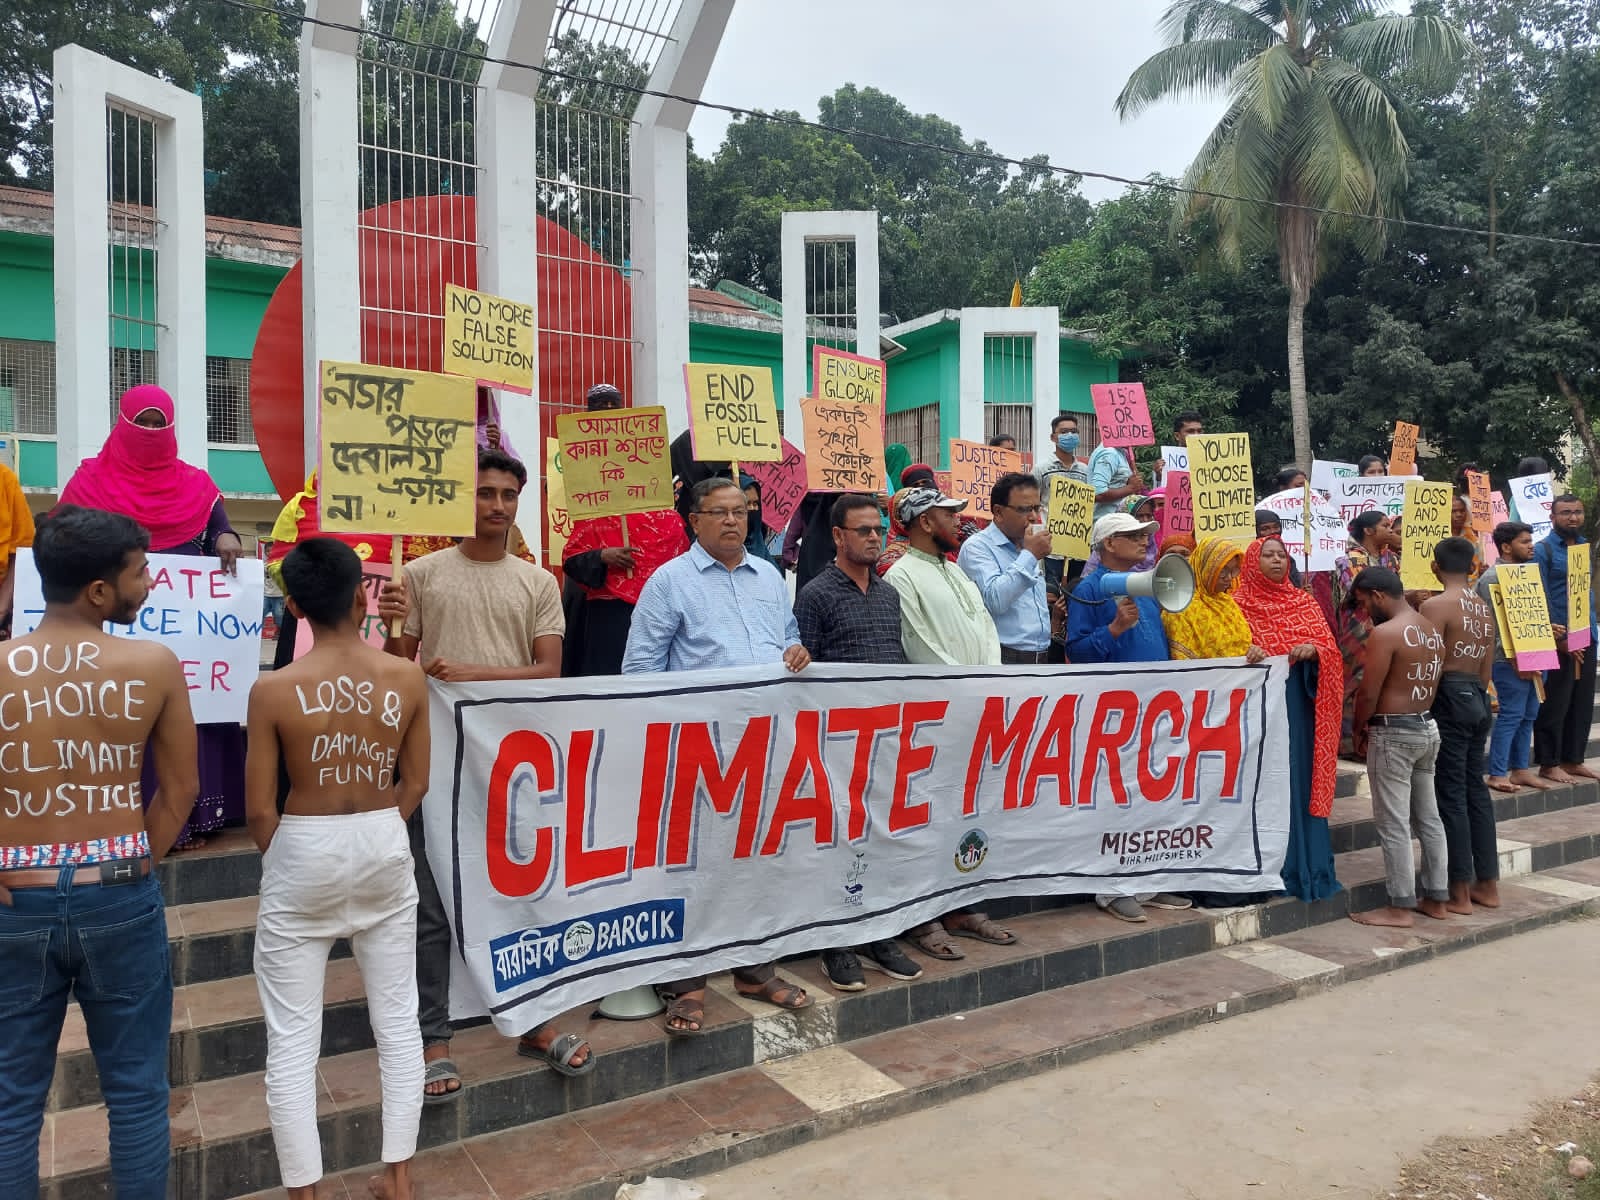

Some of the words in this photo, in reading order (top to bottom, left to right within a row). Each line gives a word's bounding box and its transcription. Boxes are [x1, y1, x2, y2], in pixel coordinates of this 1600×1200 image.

[452, 292, 482, 315] NO
[488, 301, 533, 327] MORE
[463, 318, 517, 348] FALSE
[452, 339, 534, 370] SOLUTION
[826, 358, 880, 383] ENSURE
[706, 373, 754, 401] END
[705, 402, 767, 424] FOSSIL
[1115, 407, 1134, 423] OR
[576, 414, 663, 436] আমাদের
[1102, 424, 1148, 439] SUICIDE
[716, 426, 777, 449] FUEL.
[564, 439, 608, 460] কান্না
[955, 444, 1007, 467] JUSTICE
[1168, 453, 1188, 468] NO
[1198, 437, 1245, 462] YOUTH
[600, 461, 624, 485] কি
[1196, 464, 1248, 486] CHOOSE
[572, 490, 612, 507] পান
[956, 480, 992, 496] JUSTI
[1056, 480, 1094, 503] PROMOTE
[1199, 488, 1252, 509] CLIMATE
[1342, 482, 1404, 497] আমাদের
[1414, 486, 1447, 506] LOSS
[1061, 502, 1086, 520] AGRO
[1171, 497, 1192, 510] GLO
[1415, 507, 1438, 521] AND
[1405, 524, 1449, 538] DAMAGE
[1414, 541, 1435, 558] FUN
[1506, 565, 1527, 579] WE
[1506, 583, 1538, 595] WANT
[1506, 597, 1543, 609] JUSTICE
[1576, 597, 1582, 619] B
[197, 610, 263, 639] NOW
[1508, 610, 1546, 623] CLIMATE
[1513, 623, 1552, 639] JUSTICE
[8, 642, 100, 677] OUR
[0, 680, 146, 731] CHOICE
[296, 675, 374, 715] LOSS
[381, 690, 401, 732] &
[0, 740, 144, 775] CLIMATE
[312, 731, 395, 769] DAMAGE
[320, 762, 391, 790] FUND
[4, 781, 141, 818] JUSTICE
[486, 700, 949, 898] CLIMATE
[962, 688, 1248, 816] MARCH
[1100, 824, 1213, 855] MISEREOR
[597, 910, 675, 952] BARCIK
[494, 929, 562, 981] বারসিক
